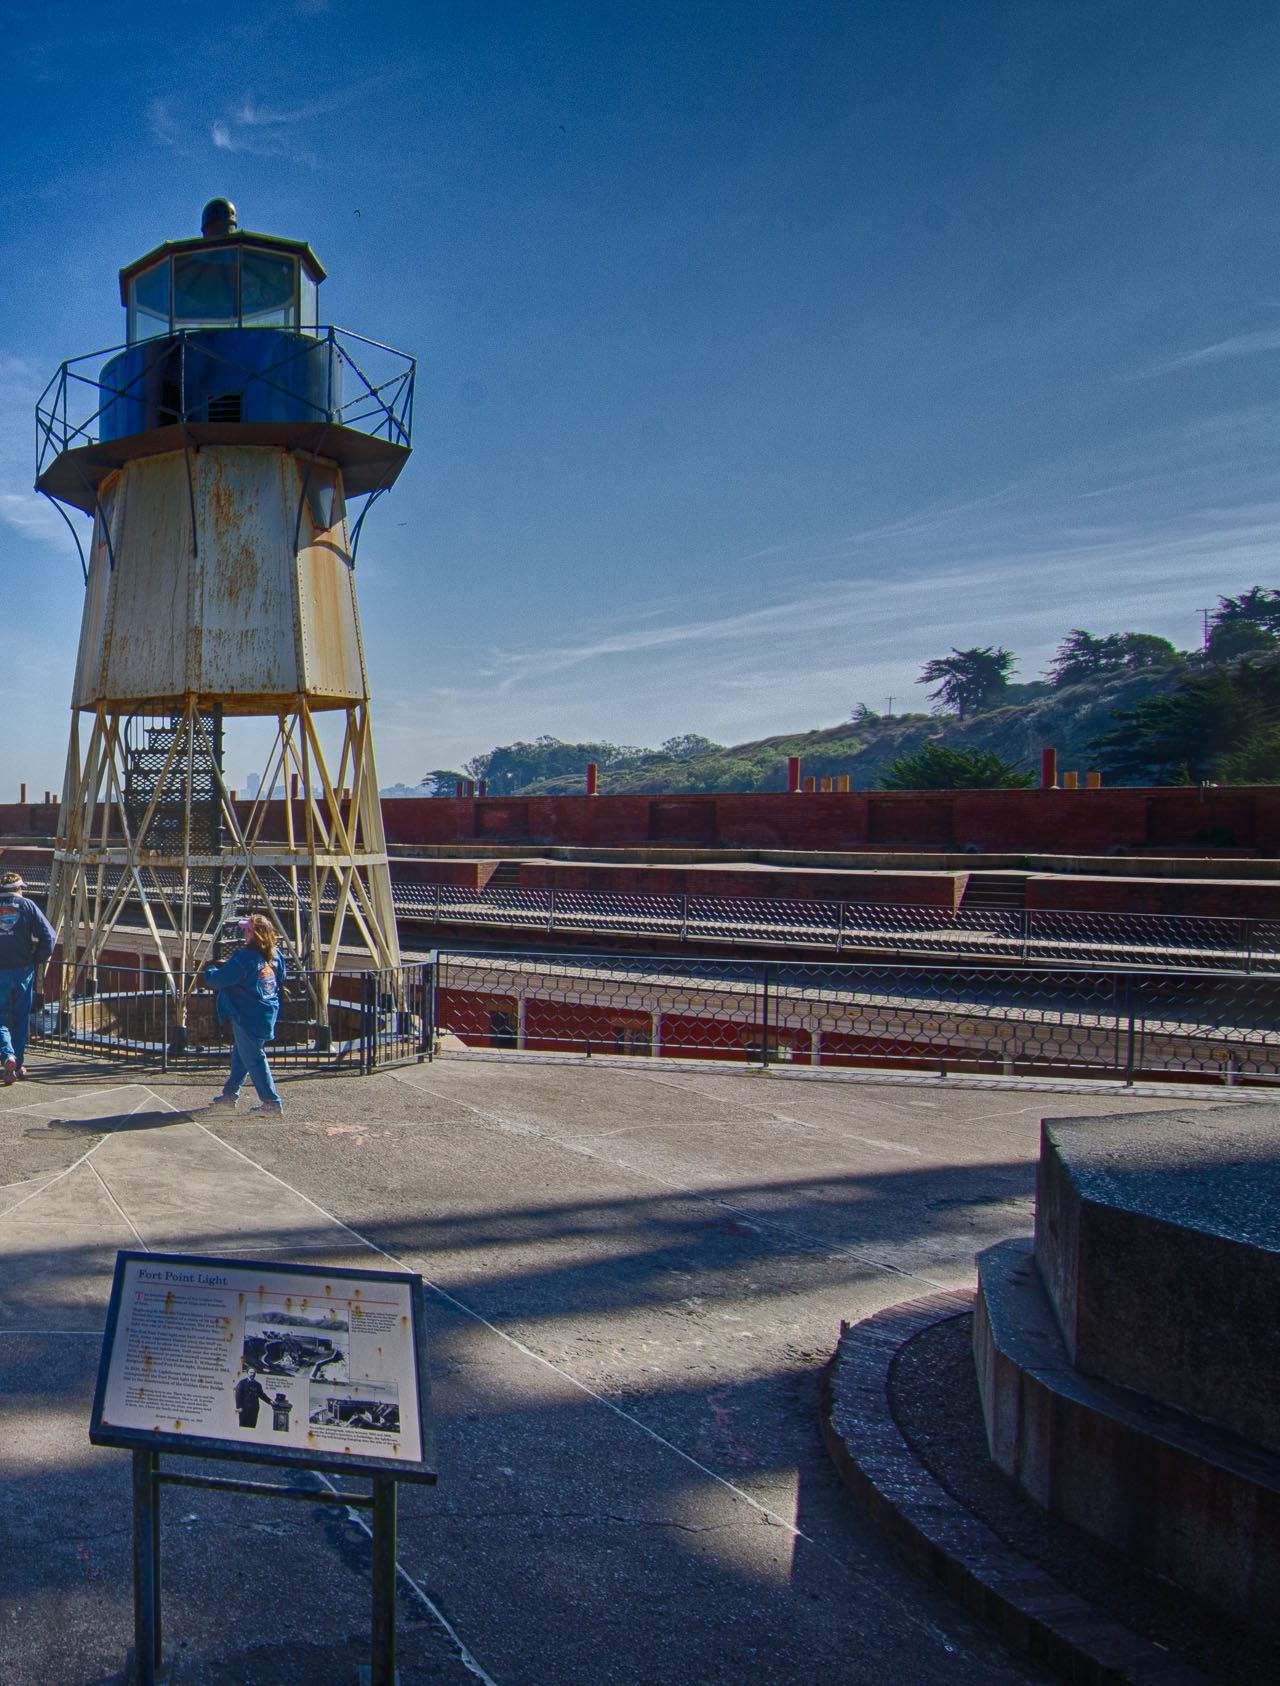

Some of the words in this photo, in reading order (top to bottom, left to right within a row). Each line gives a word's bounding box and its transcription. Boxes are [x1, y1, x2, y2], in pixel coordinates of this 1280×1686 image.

[138, 1268, 162, 1280] Fort
[165, 1271, 194, 1283] Point
[198, 1273, 229, 1287] Light
